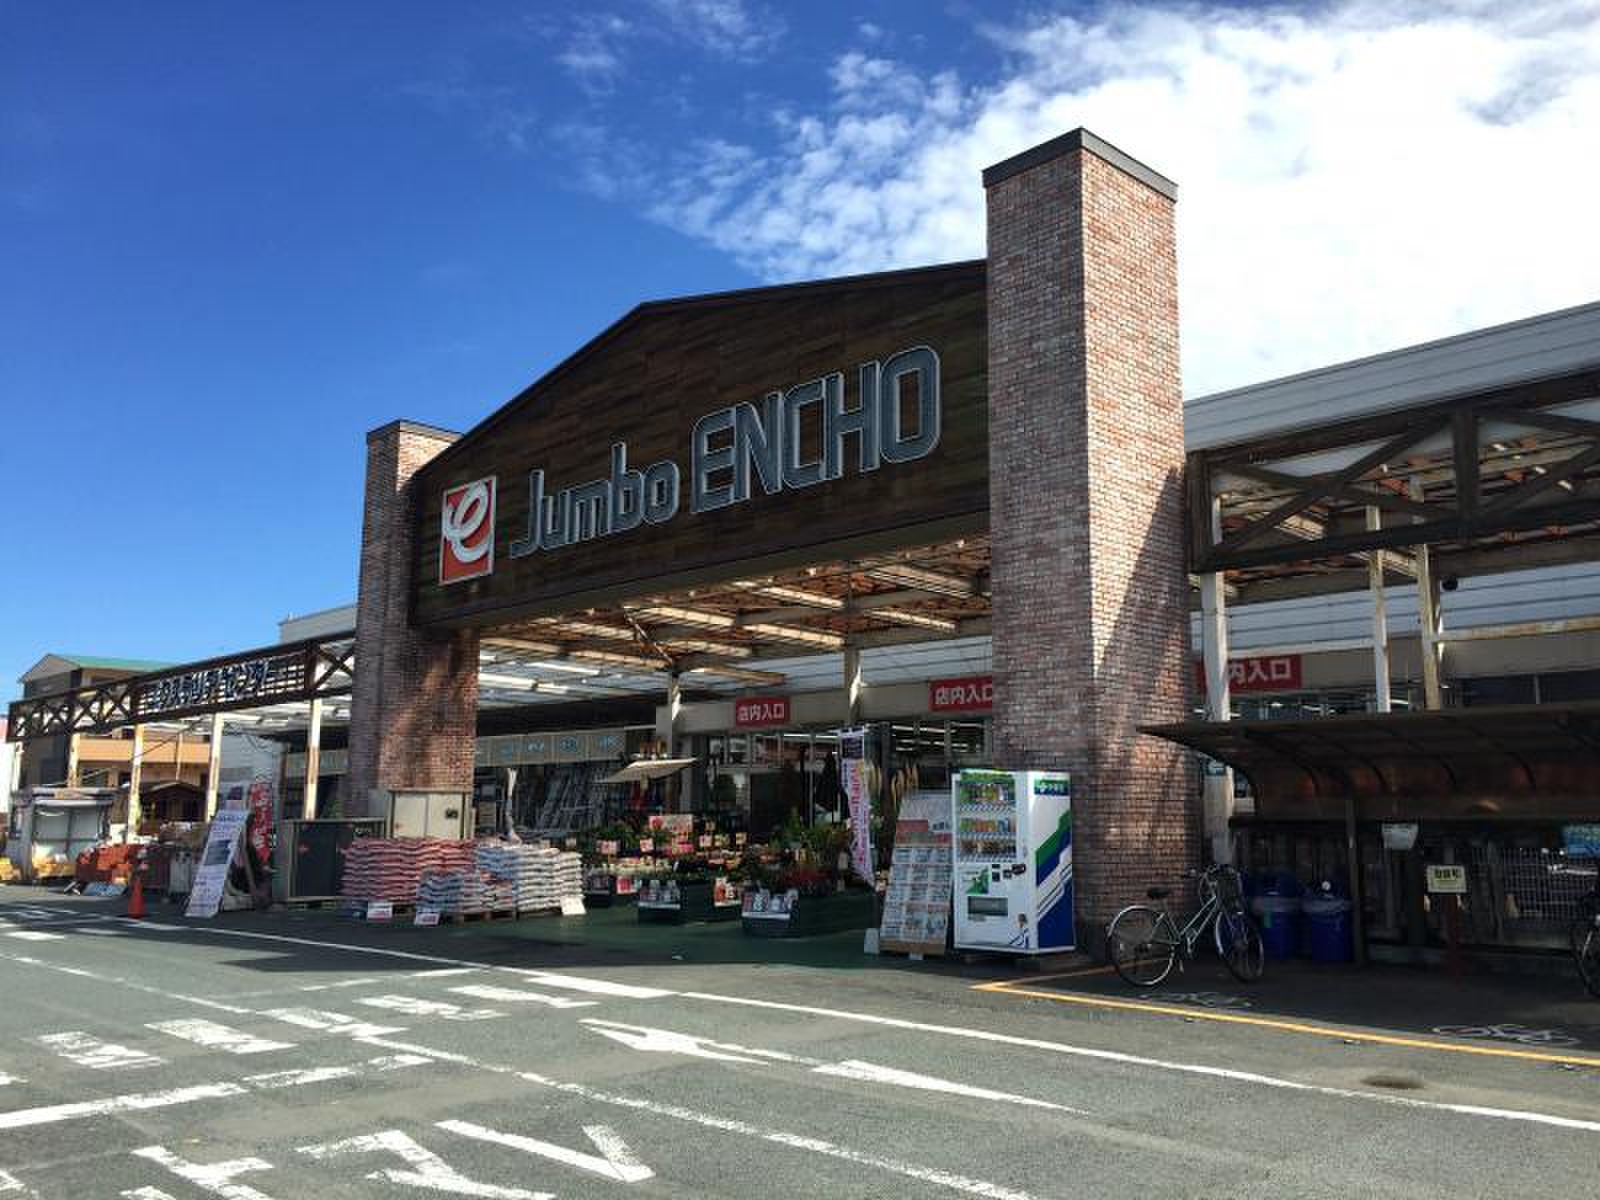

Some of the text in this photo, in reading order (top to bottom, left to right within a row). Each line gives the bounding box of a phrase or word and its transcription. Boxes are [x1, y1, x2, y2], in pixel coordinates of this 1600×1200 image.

[509, 442, 681, 559] Jumbo
[690, 345, 942, 514] ENCHO
[1226, 658, 1292, 685] 内入口
[737, 702, 785, 721] 店内入口
